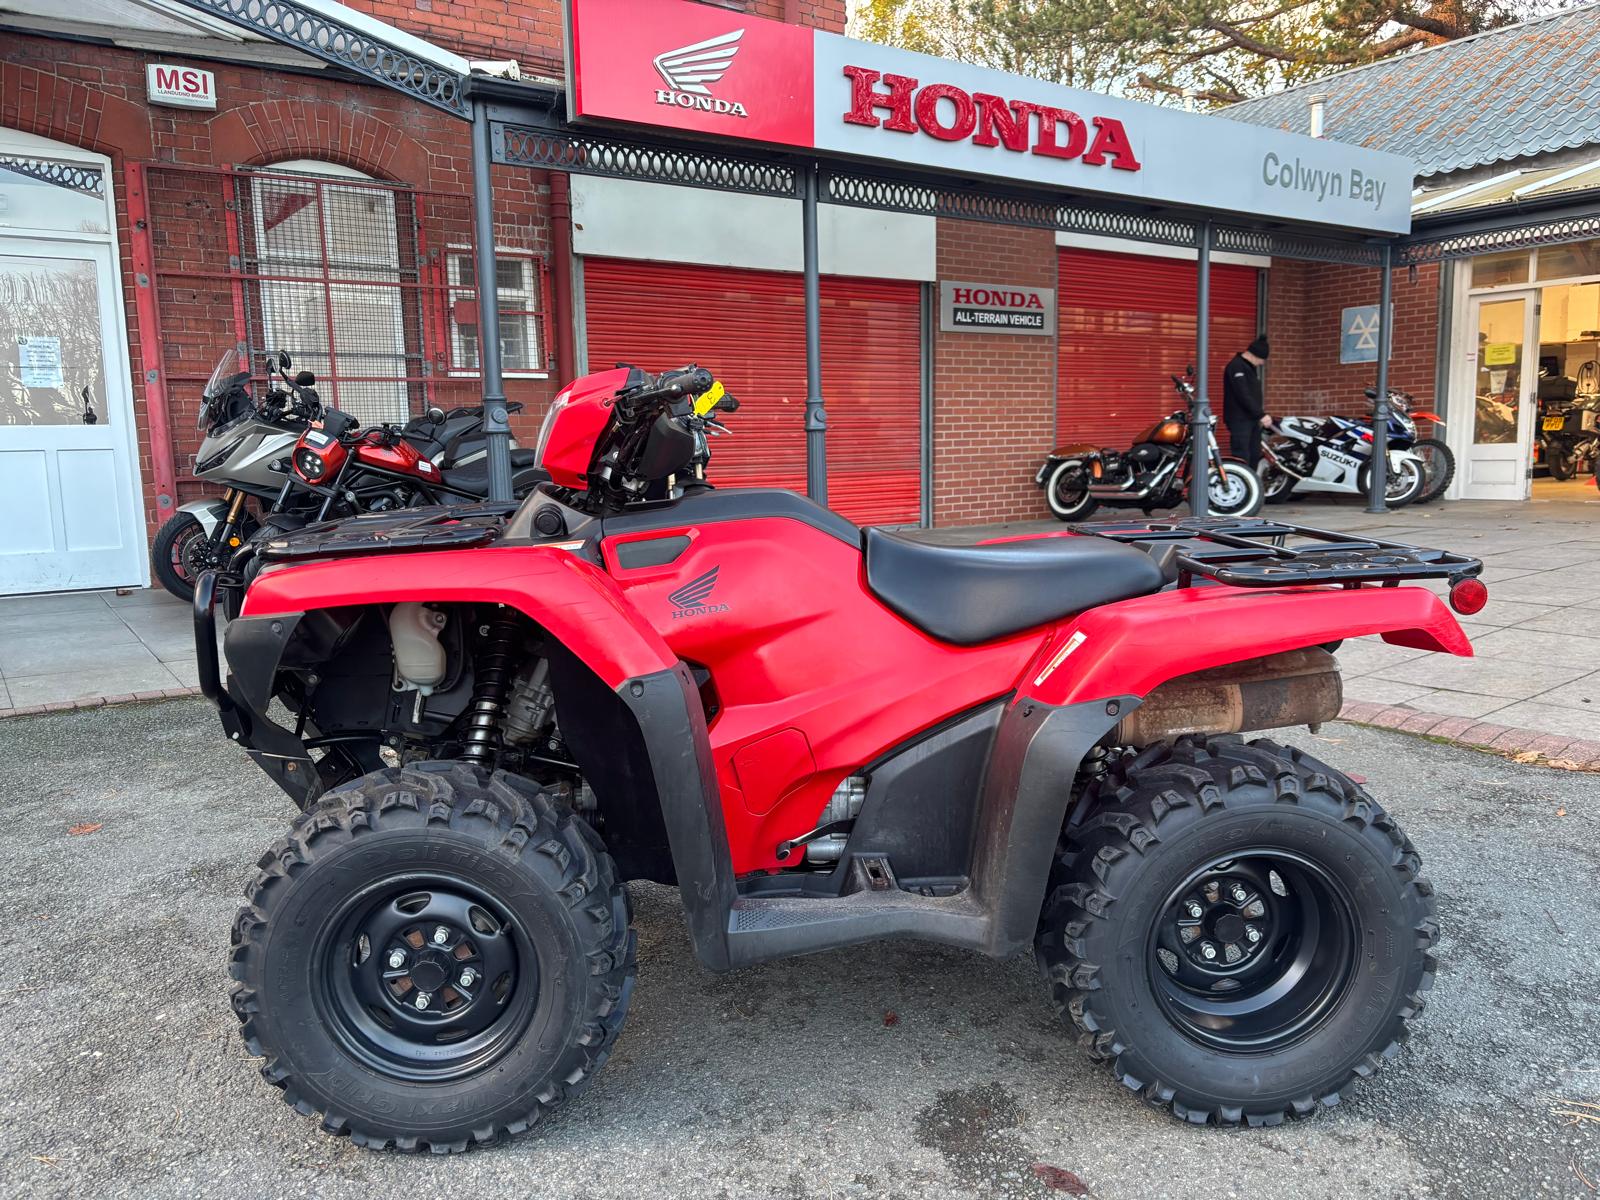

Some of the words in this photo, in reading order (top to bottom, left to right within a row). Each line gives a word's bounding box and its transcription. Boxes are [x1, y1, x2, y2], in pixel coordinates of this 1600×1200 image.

[157, 68, 208, 94] MSI
[655, 89, 748, 117] HONDA
[843, 64, 1141, 172] HONDA
[1263, 152, 1342, 202] Colwyn
[1350, 168, 1386, 211] Bay
[952, 287, 1045, 309] HONDA
[955, 311, 1008, 325] ALL-TERRAIN
[1009, 314, 1042, 326] VEHICLE
[1320, 449, 1358, 469] SUZUKI
[672, 603, 729, 619] HONDA
